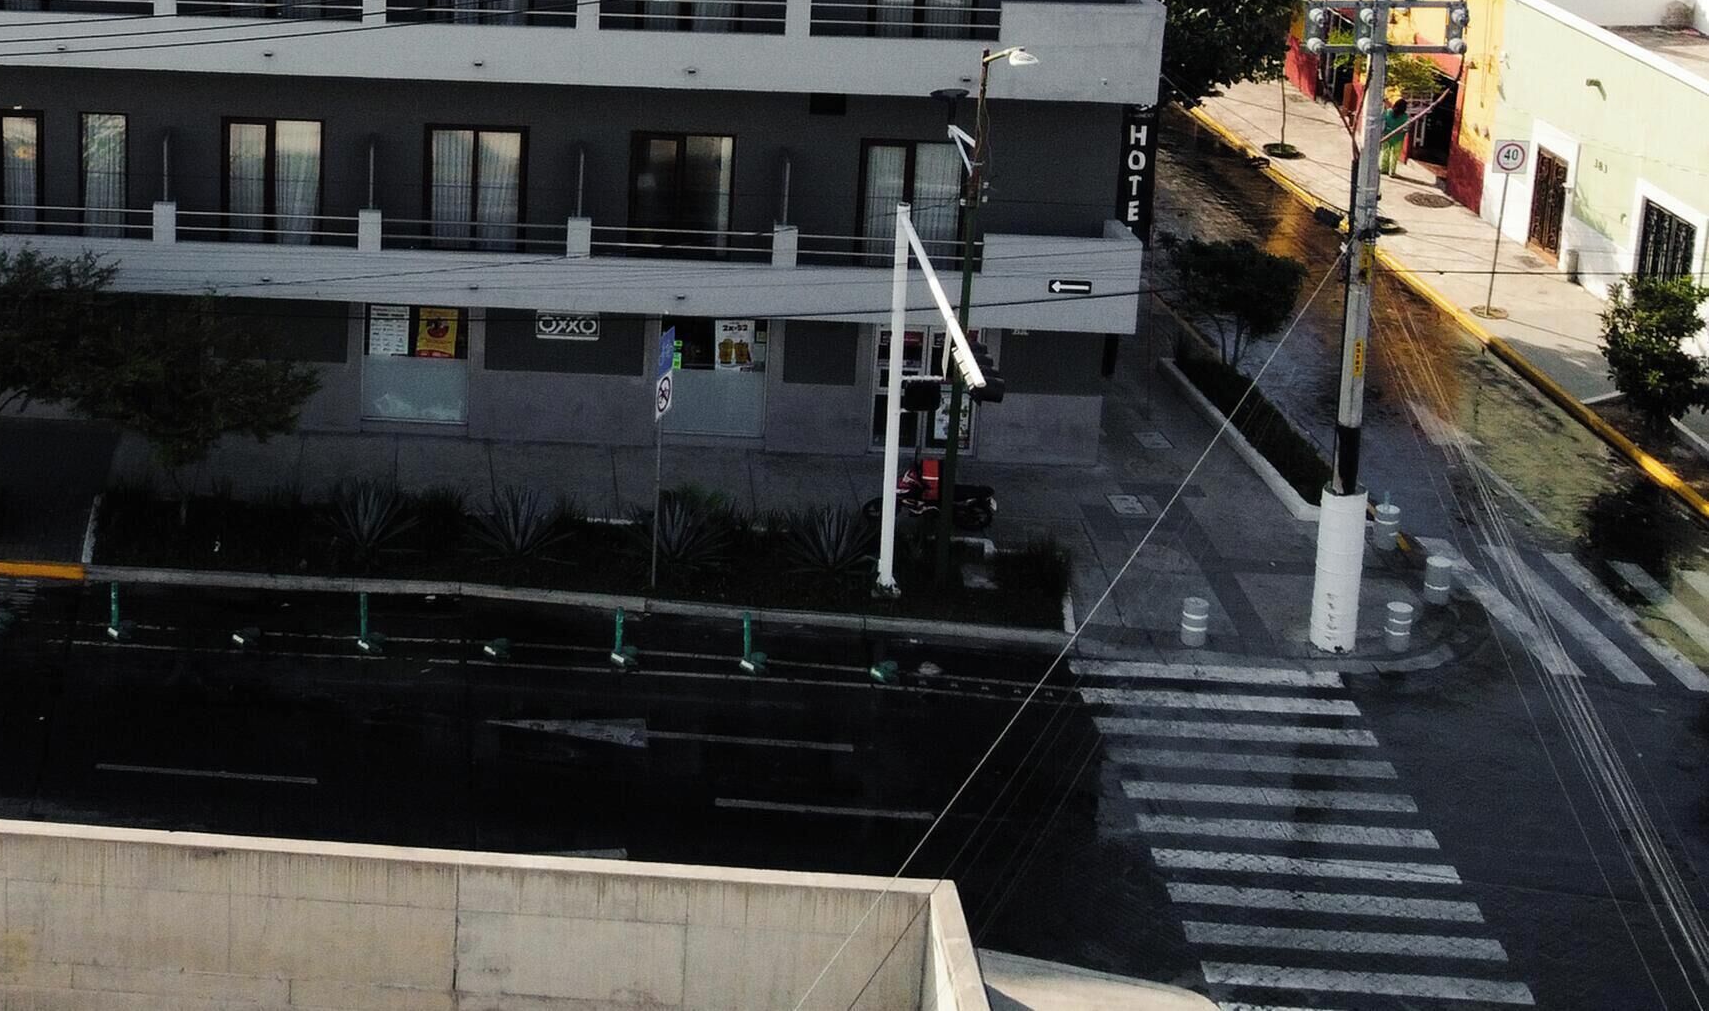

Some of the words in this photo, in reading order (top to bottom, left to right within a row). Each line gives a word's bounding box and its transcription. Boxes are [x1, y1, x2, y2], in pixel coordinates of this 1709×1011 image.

[1504, 148, 1518, 160] 40
[1127, 124, 1148, 230] HOTE
[538, 316, 597, 335] OXXO
